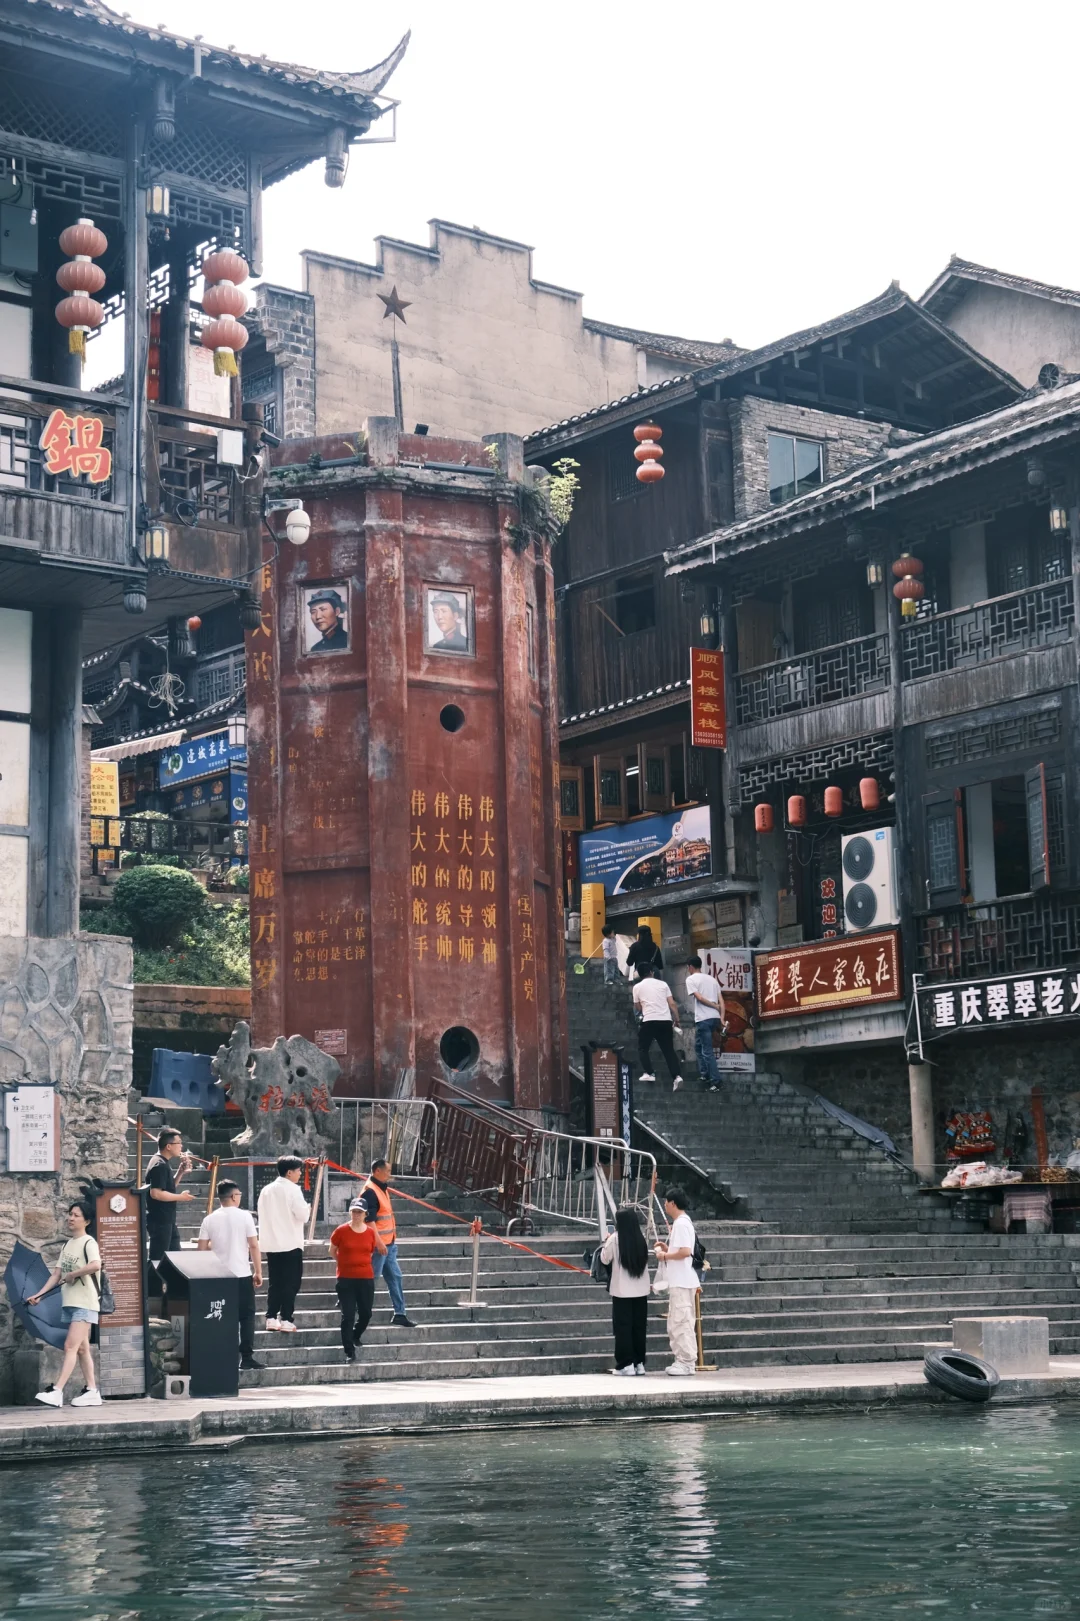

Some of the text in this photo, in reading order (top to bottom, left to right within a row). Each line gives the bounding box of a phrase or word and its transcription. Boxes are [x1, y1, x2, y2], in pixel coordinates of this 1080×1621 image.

[411, 789, 429, 961] 伟大的舵手
[434, 791, 453, 962] 伟大的统帅
[457, 793, 474, 963] 伟大的导师
[479, 795, 497, 965] 伟大的领袖
